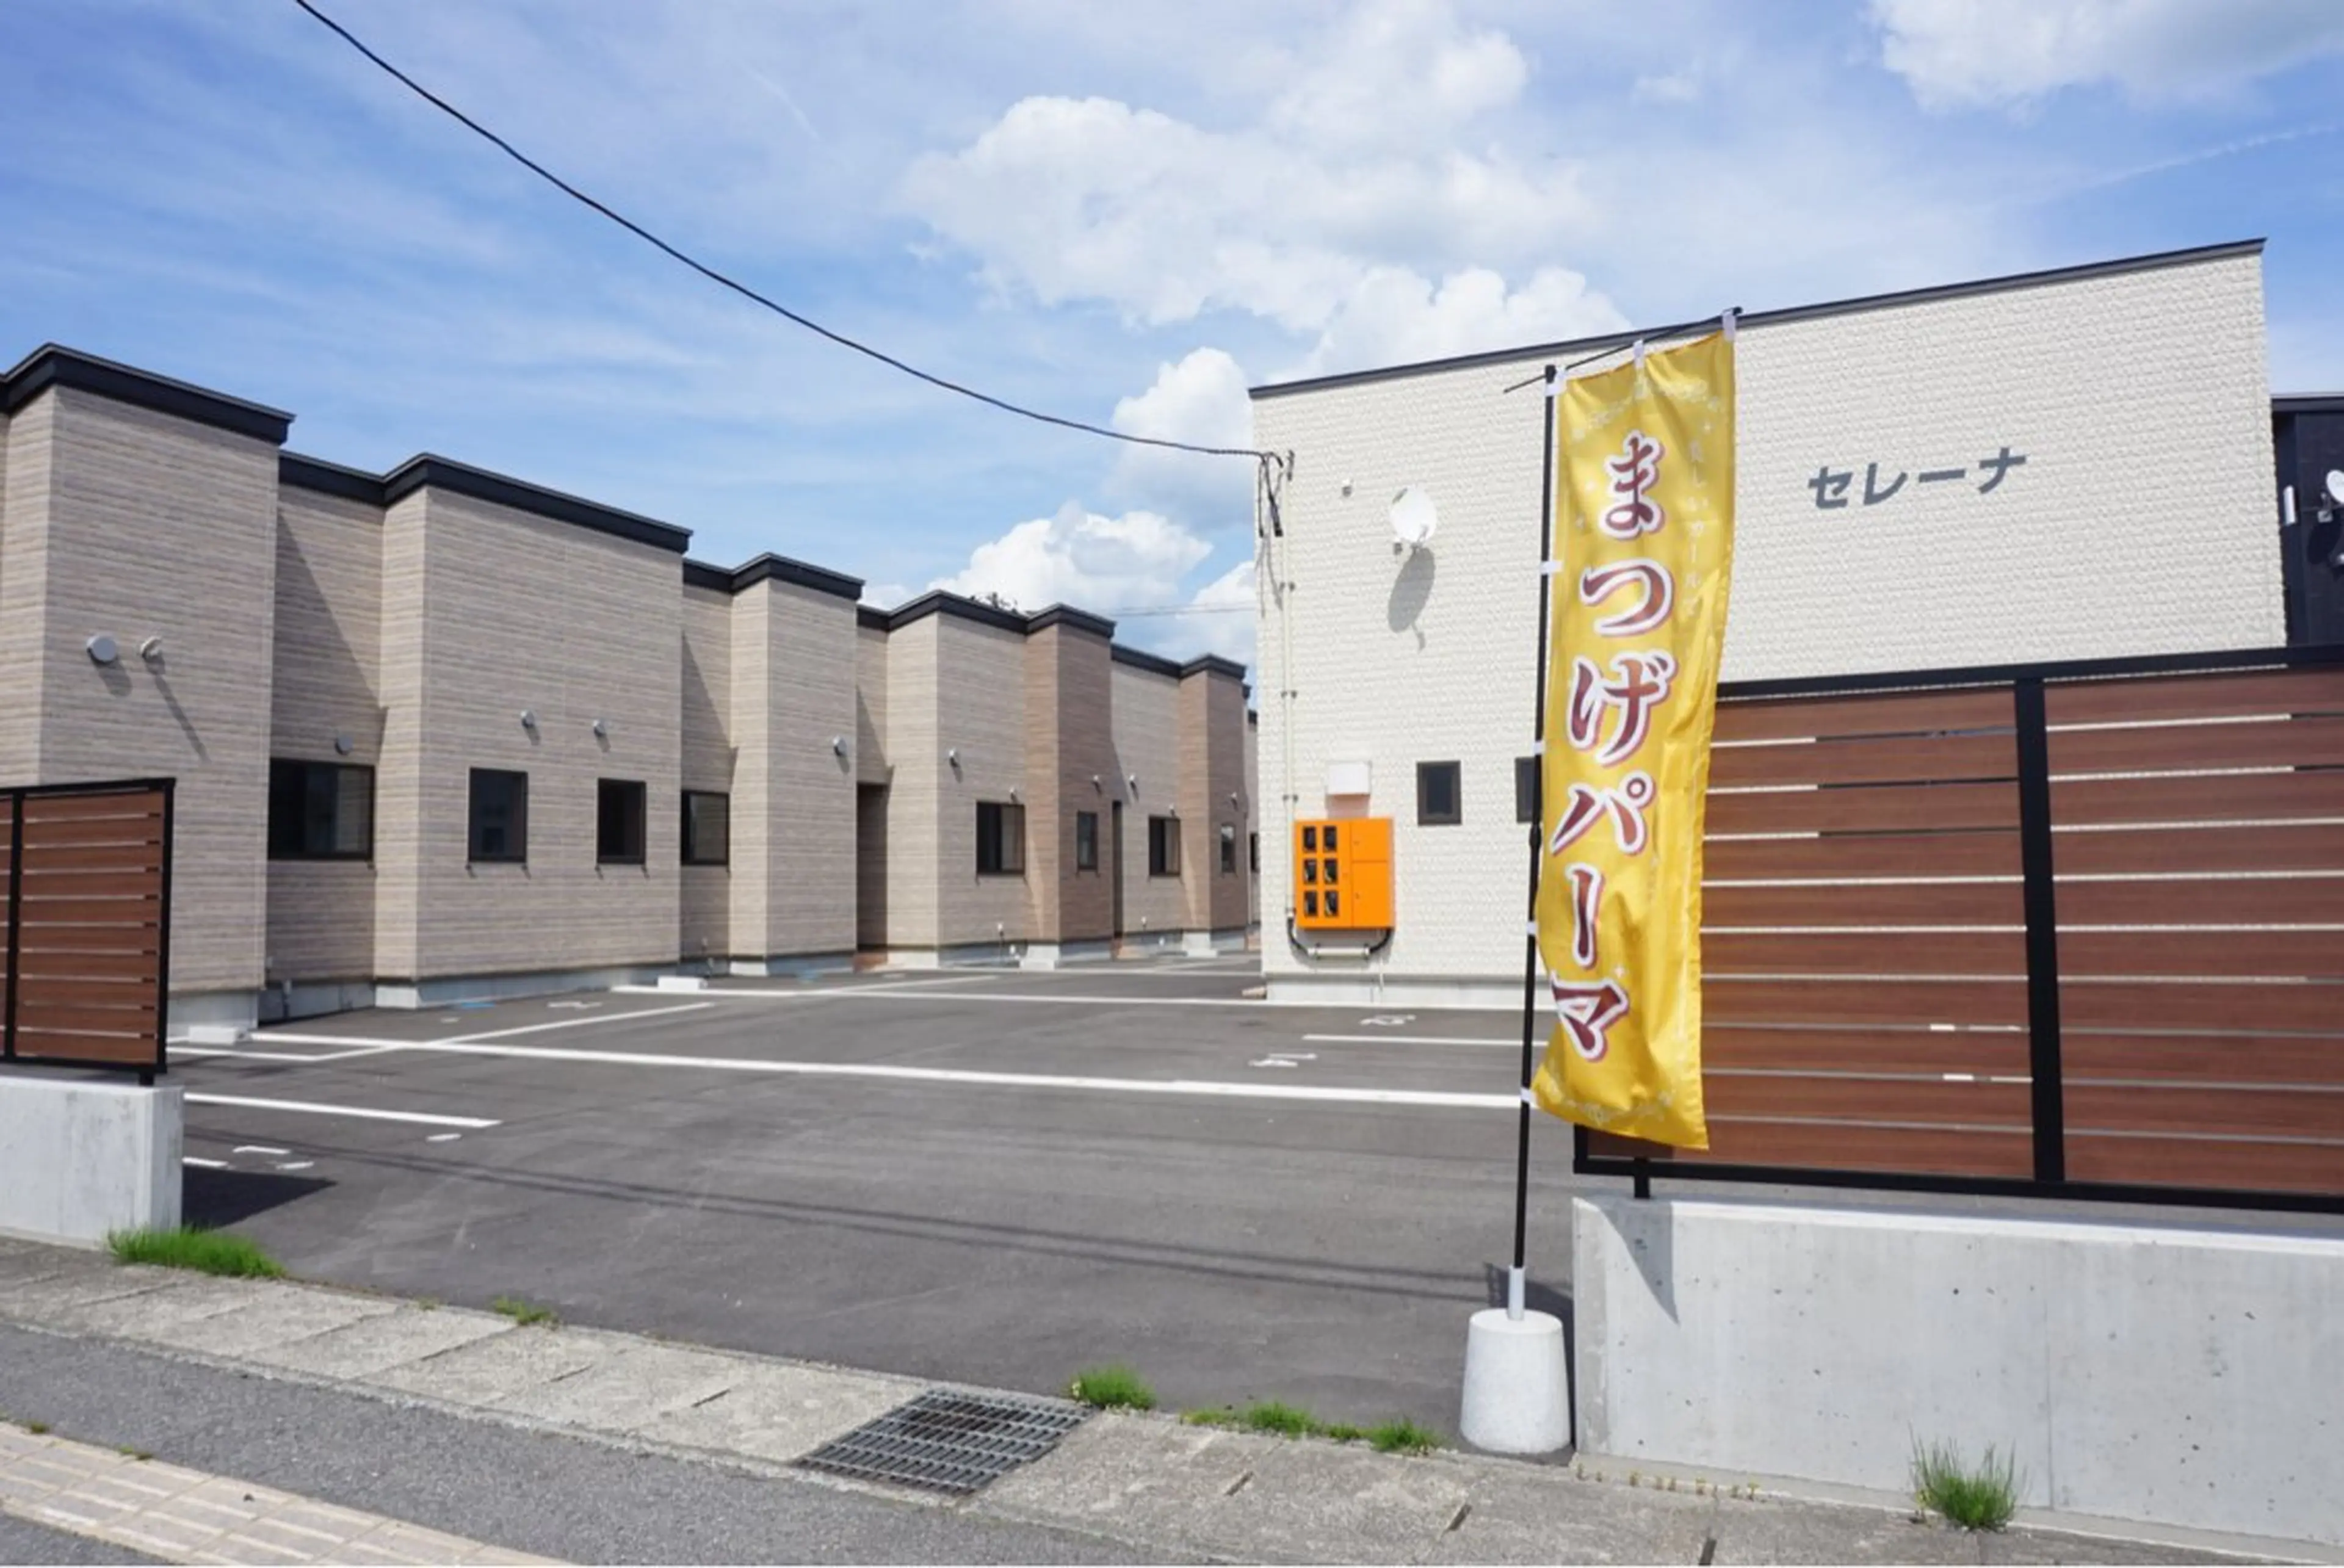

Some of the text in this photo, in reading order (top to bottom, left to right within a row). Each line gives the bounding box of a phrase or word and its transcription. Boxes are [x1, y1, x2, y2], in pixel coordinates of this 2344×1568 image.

[1807, 447, 2027, 508] セレーナ
[1551, 430, 1677, 1061] まつげパーマ
